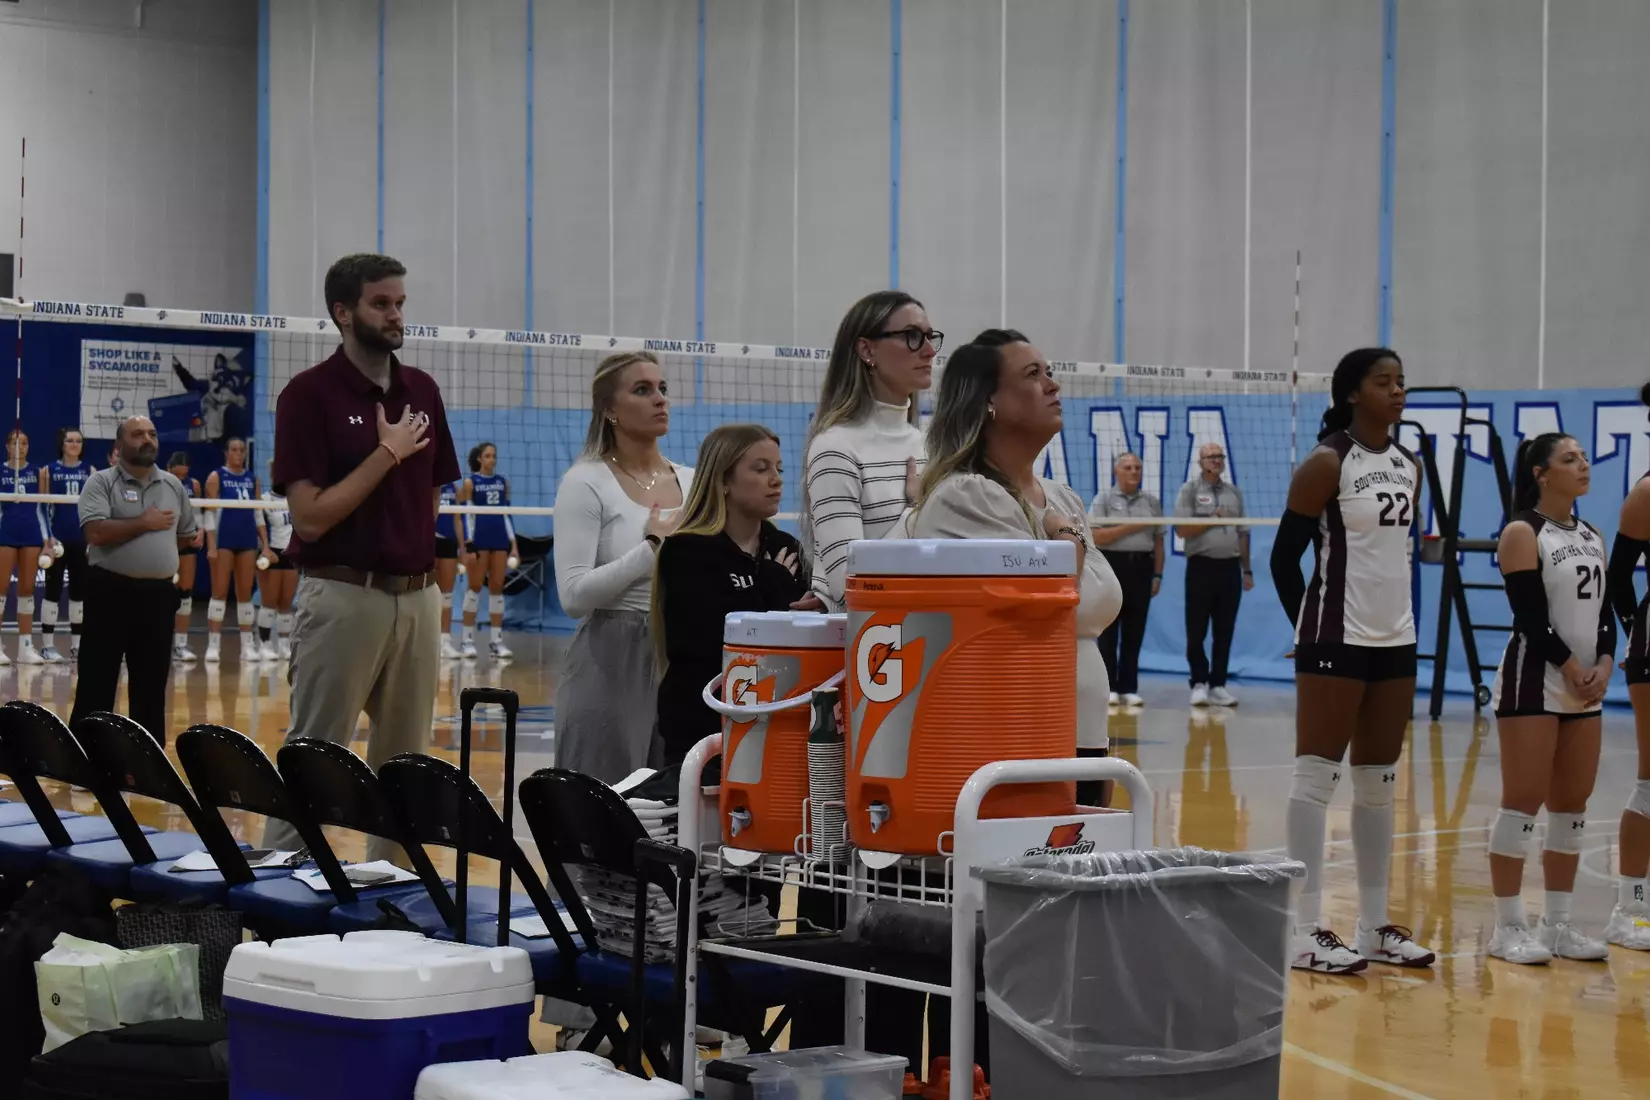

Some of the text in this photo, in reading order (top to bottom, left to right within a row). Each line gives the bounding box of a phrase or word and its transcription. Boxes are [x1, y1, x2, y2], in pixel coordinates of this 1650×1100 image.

[33, 301, 124, 319] INDIANA STATE
[200, 312, 287, 329] INDIANA STATE
[405, 325, 439, 338] STATE
[505, 330, 582, 346] INDIANA STATE
[644, 339, 716, 354] INDIANA STATE
[775, 347, 813, 359] INDIANA
[88, 348, 162, 362] SHOP LIKE A
[88, 360, 160, 374] SYCAMORE!
[1051, 361, 1078, 373] STATE
[1127, 365, 1186, 378] INDIANA STATE
[1233, 370, 1287, 382] INDIANA STATE
[65, 481, 80, 495] 10
[1354, 470, 1390, 494] SOUTHERN
[486, 490, 500, 504] 22
[1376, 491, 1410, 527] 22
[1002, 554, 1022, 568] ISU
[1576, 564, 1601, 600] 21
[856, 624, 904, 703] G
[723, 665, 758, 724] G
